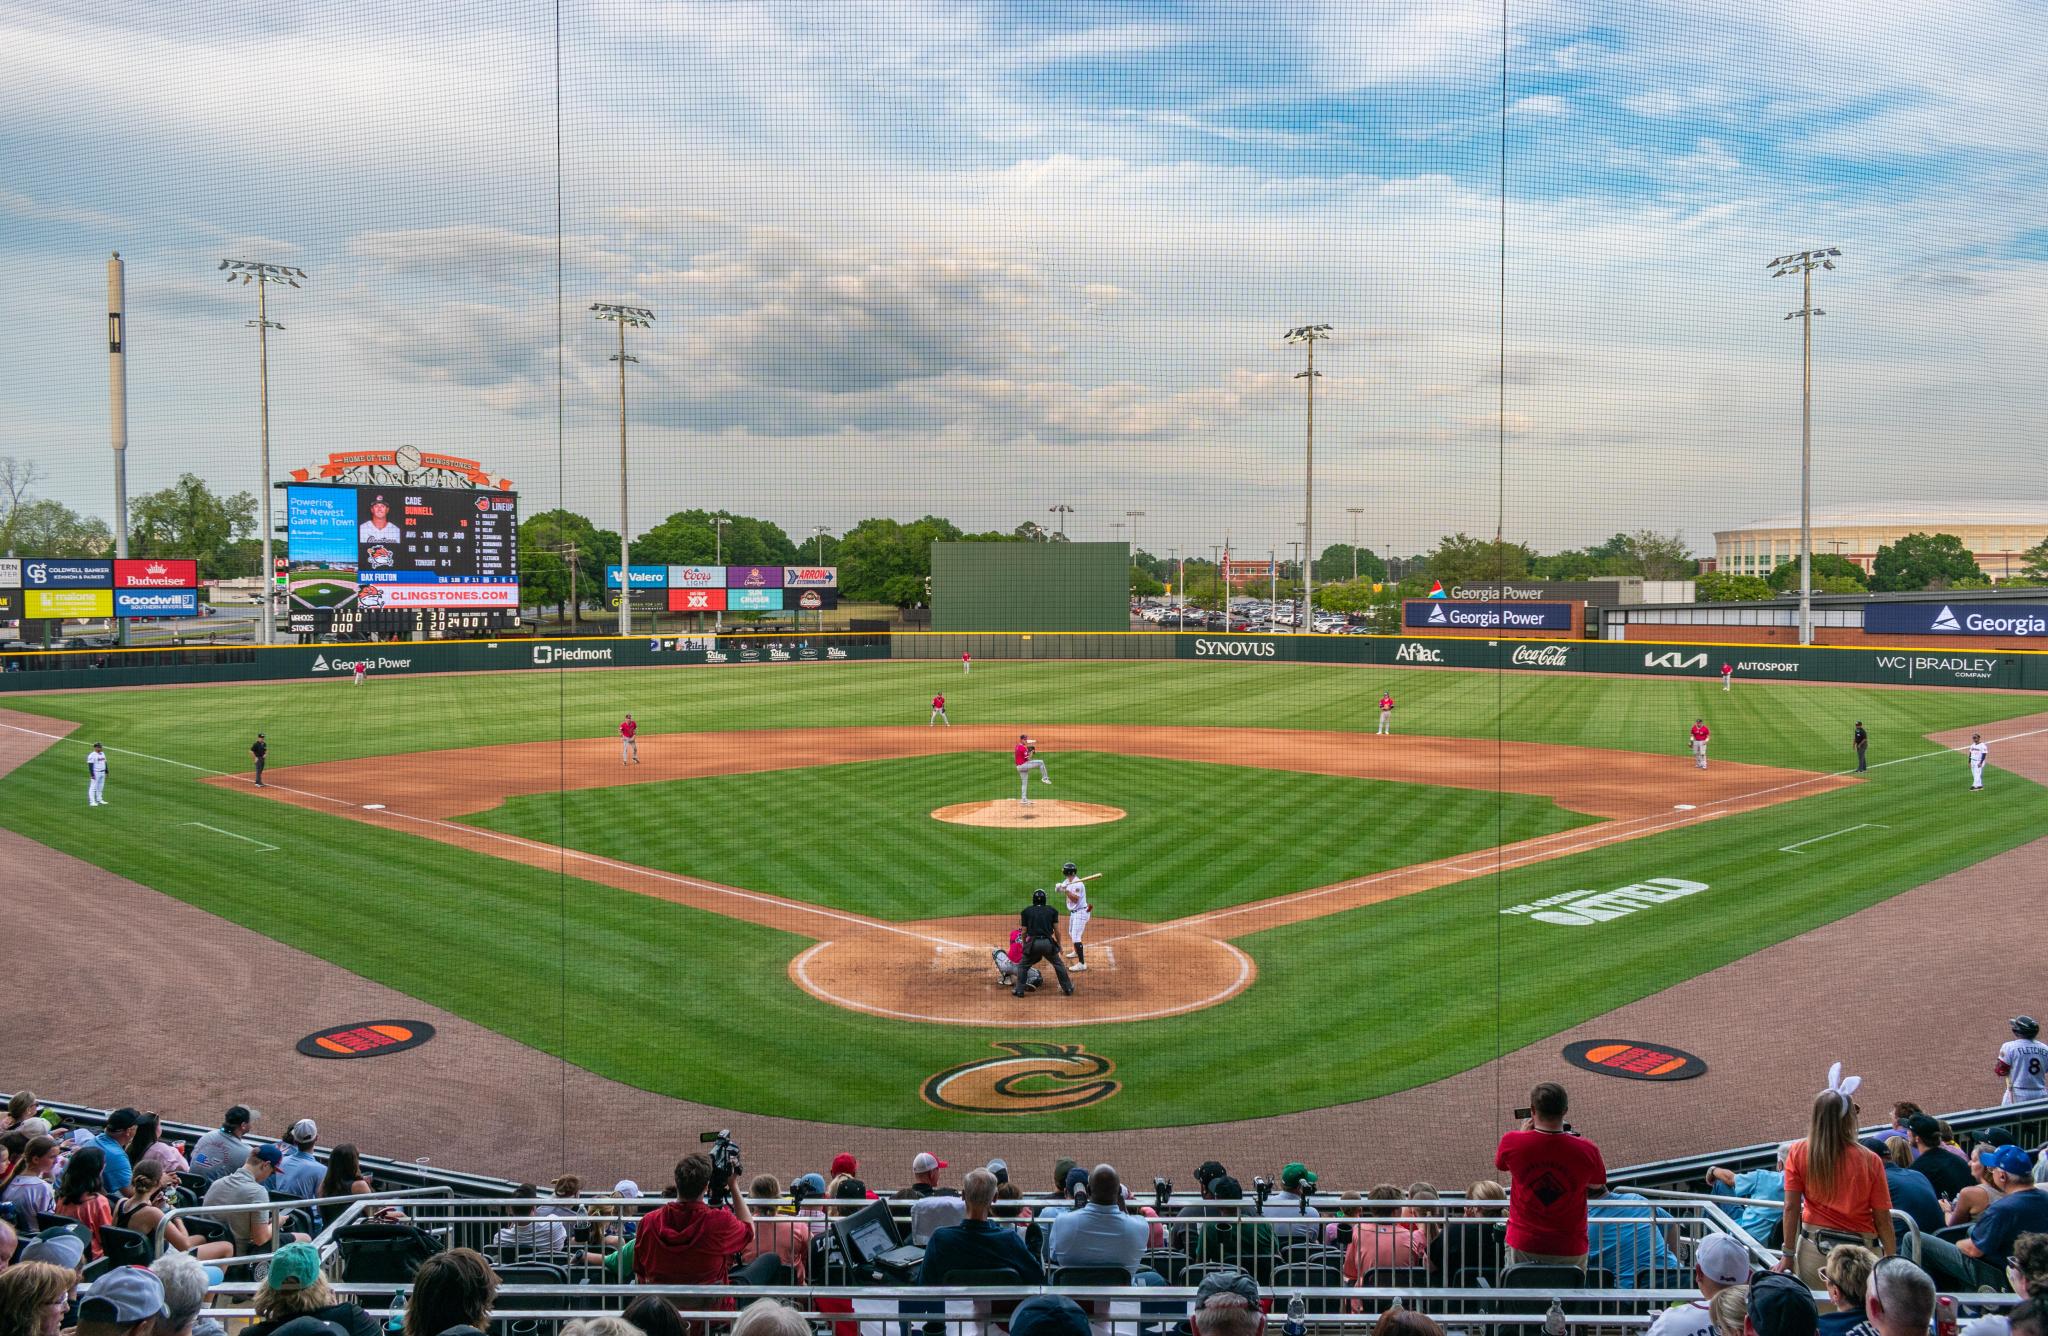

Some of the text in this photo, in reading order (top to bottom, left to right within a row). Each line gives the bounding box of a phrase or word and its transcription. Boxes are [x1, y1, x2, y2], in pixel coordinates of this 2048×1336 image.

[343, 468, 465, 489] SYNOVUS PARK
[291, 498, 333, 509] Powering
[405, 497, 422, 505] CADE
[492, 502, 514, 511] LINEUP
[291, 507, 344, 517] The Newest
[291, 516, 355, 526] Game In Town
[456, 545, 461, 553] 3
[360, 573, 397, 581] DAX FULTON
[629, 573, 664, 582] Valero
[683, 568, 711, 581] Coors
[798, 569, 827, 579] ARROW
[126, 575, 186, 586] Budweiser
[391, 591, 508, 600] CLINGSTONES.COM
[1451, 586, 1543, 602] Georgia Power
[119, 595, 182, 605] Goodwill
[687, 595, 708, 608] XX
[334, 613, 338, 622] 1
[342, 614, 346, 622] 1
[346, 613, 353, 622] 0
[355, 613, 362, 622] 0
[416, 612, 423, 620] 2
[430, 612, 437, 620] 3
[438, 612, 445, 620] 0
[447, 617, 520, 628] 24 0 0 1 0
[1450, 610, 1545, 627] Georgia Power
[291, 621, 445, 632] STONES 0 0 0 0 2 0
[1966, 613, 2046, 635] Georgia
[827, 647, 847, 656] Riley
[1195, 638, 1275, 656] SYNOVUS
[554, 648, 612, 660] Piedmont
[706, 650, 728, 660] Riley
[770, 648, 791, 659] Riley
[1512, 645, 1570, 666] Coca-Cola
[378, 657, 412, 669] Power
[1645, 652, 1708, 668] KIA
[1876, 656, 1997, 671] WC BRADLEY
[1737, 662, 1799, 672] AUTOSPORT
[326, 1032, 378, 1051] KING
[1618, 1051, 1675, 1073] KING
[2028, 1058, 2041, 1075] 8
